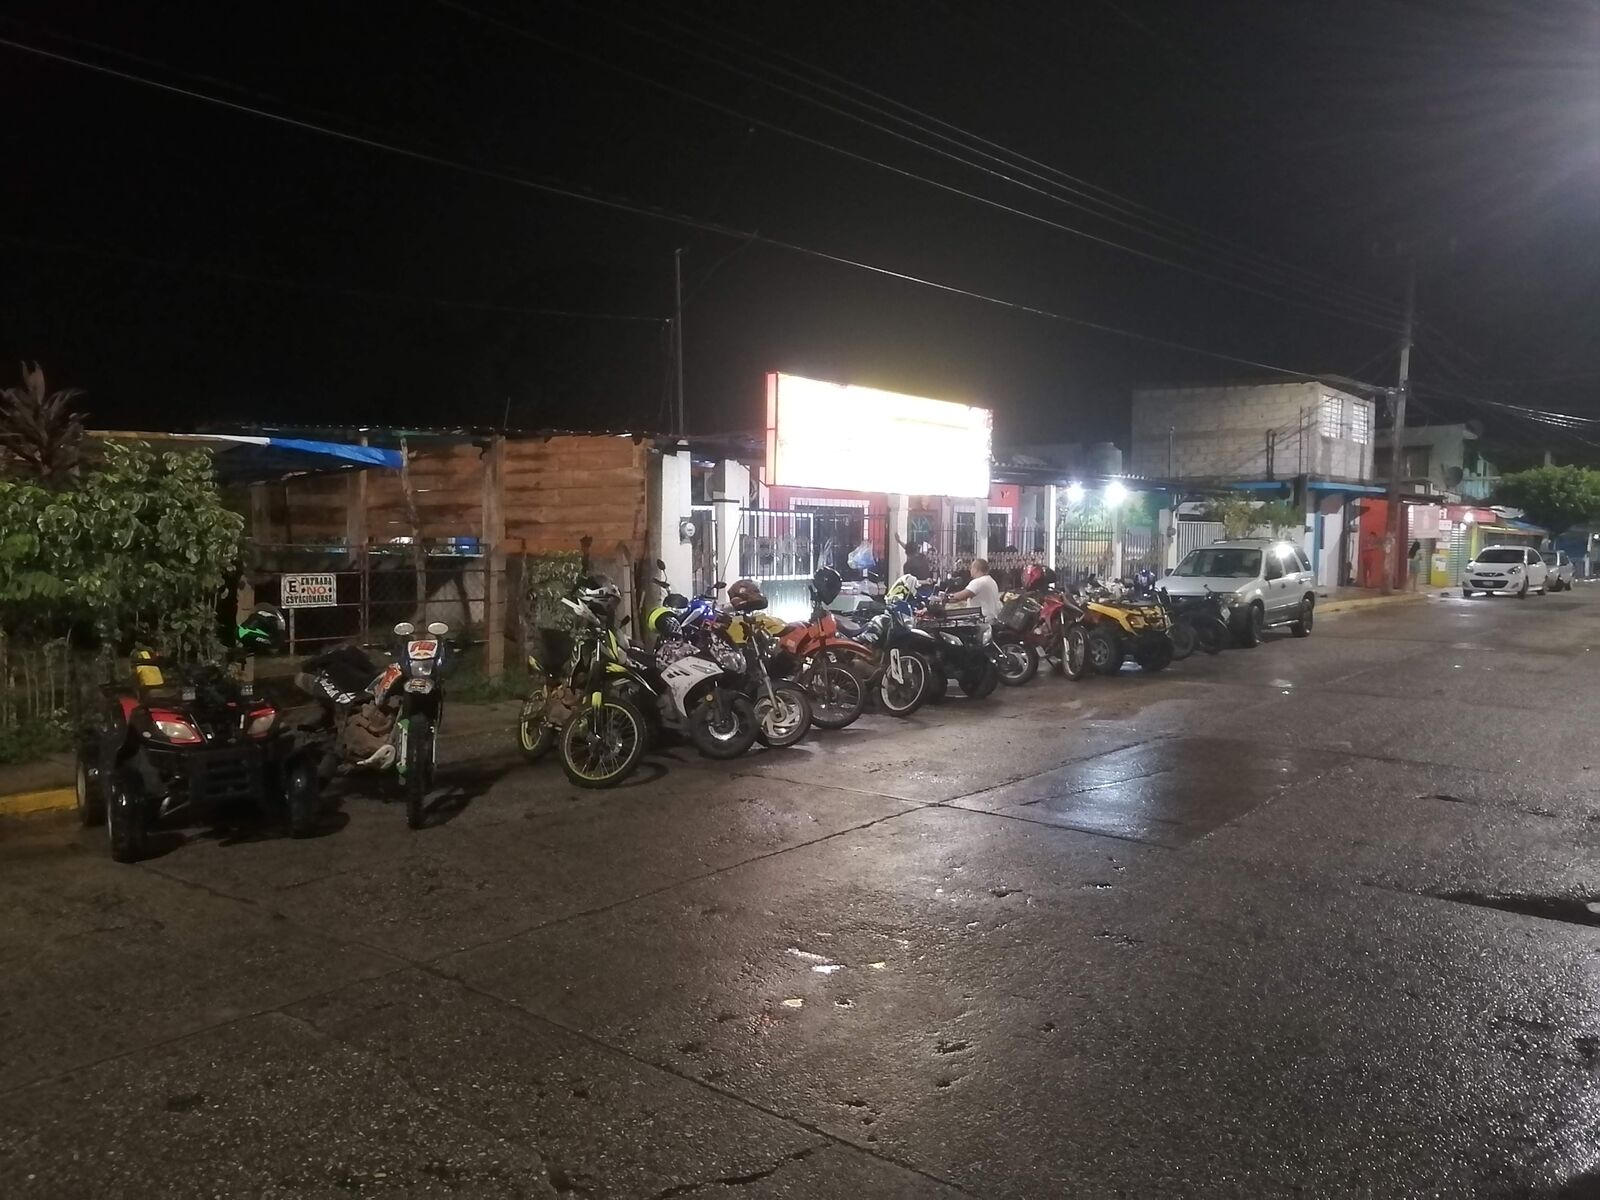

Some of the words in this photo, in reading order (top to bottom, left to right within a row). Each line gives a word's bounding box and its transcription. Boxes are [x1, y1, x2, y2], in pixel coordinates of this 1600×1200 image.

[301, 577, 332, 585] ENTRADA
[288, 580, 297, 593] E
[306, 586, 326, 594] NO
[286, 595, 332, 604] ESTACIONARSE
